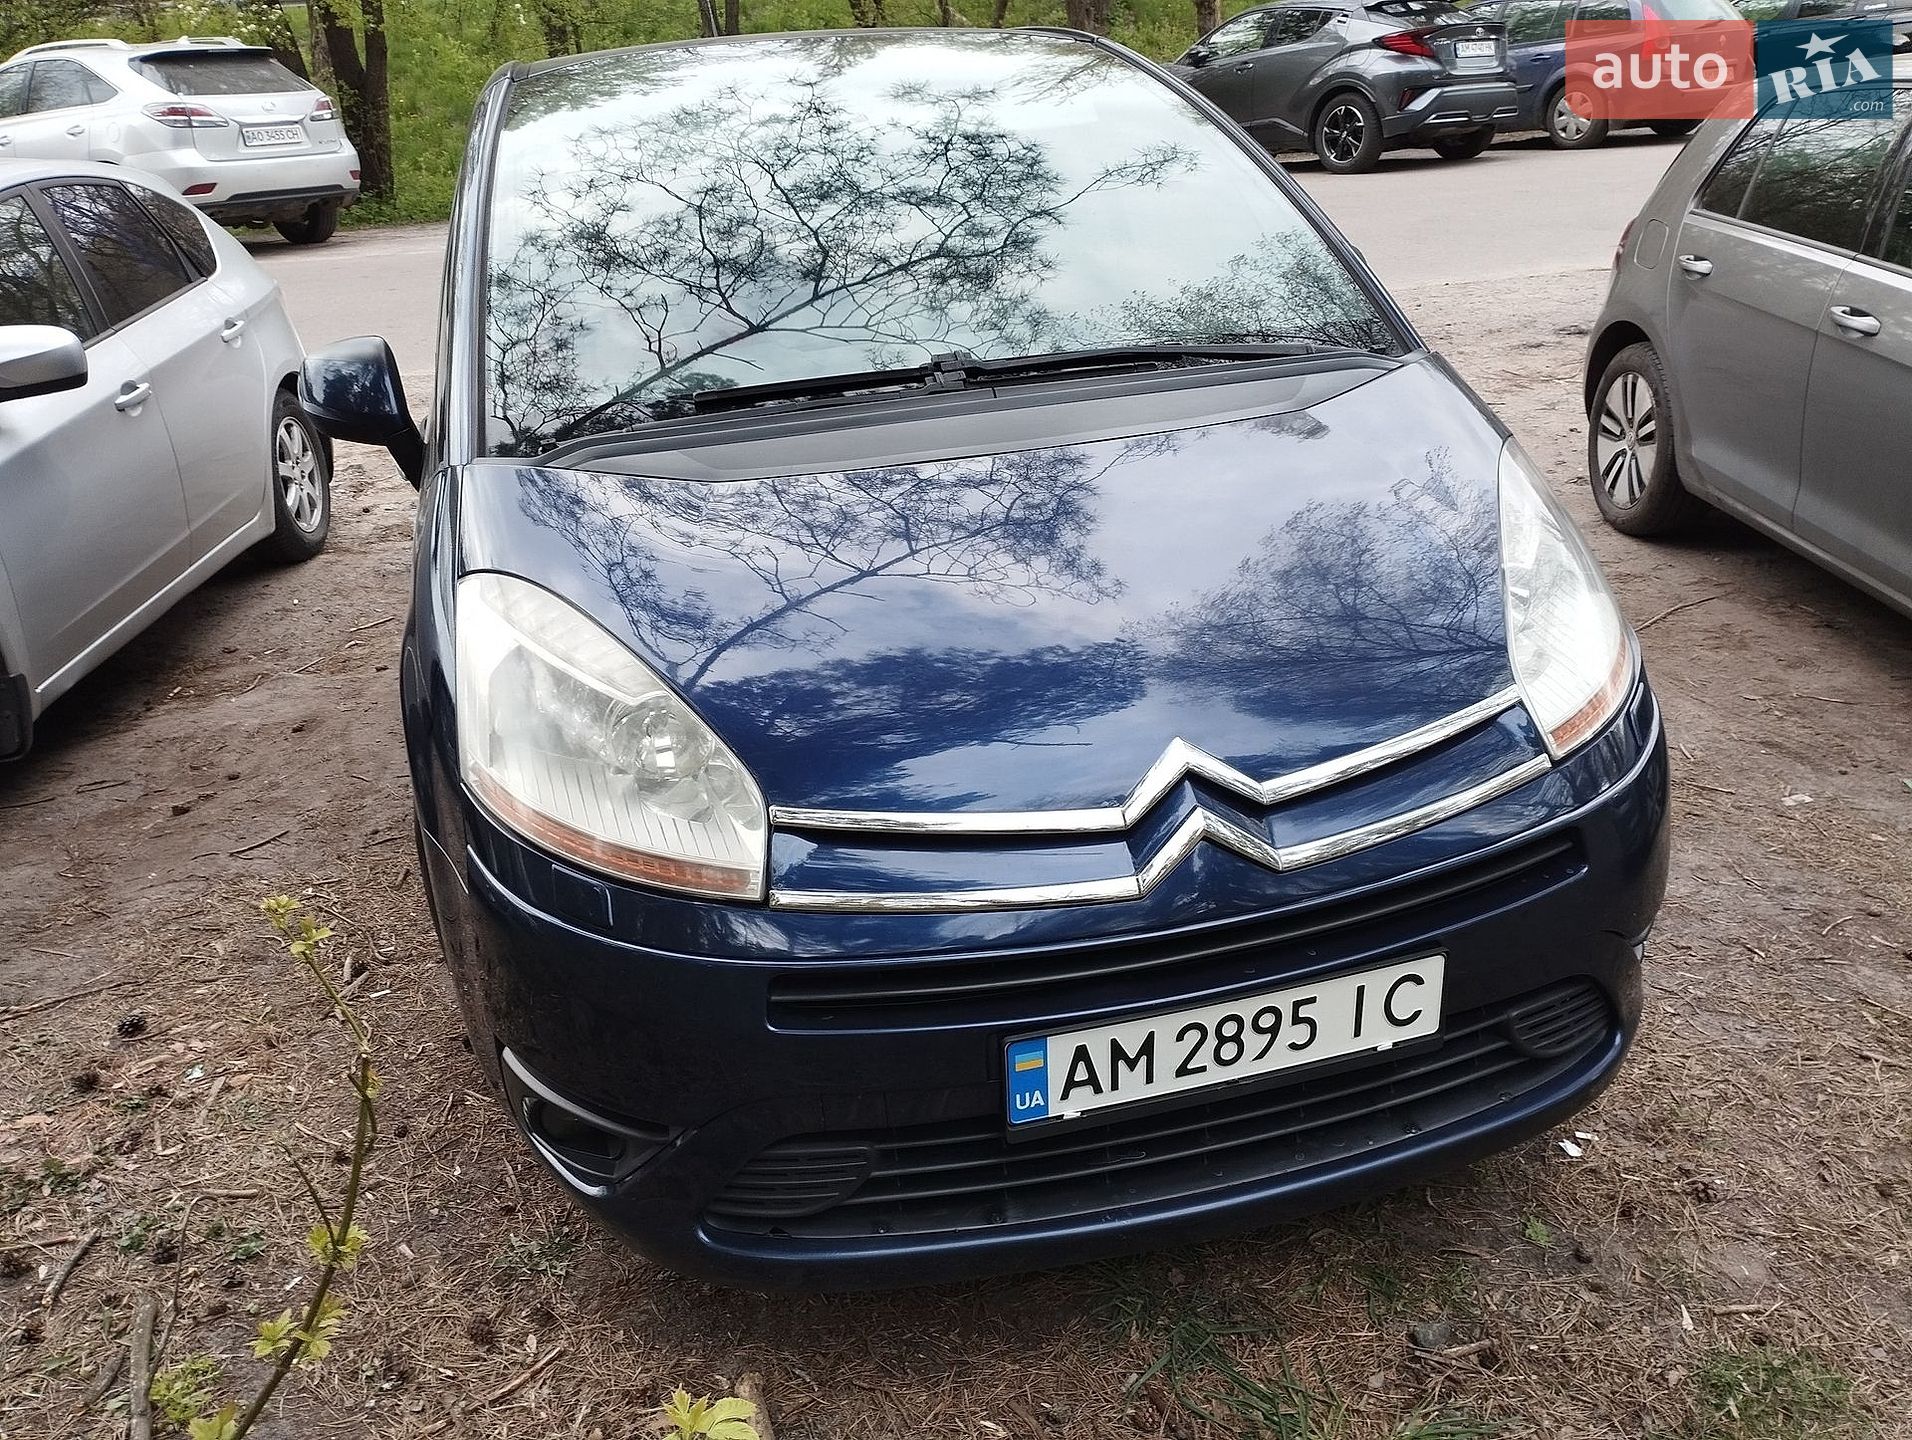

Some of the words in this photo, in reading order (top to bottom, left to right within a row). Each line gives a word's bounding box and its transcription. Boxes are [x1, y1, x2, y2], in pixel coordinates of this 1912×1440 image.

[286, 129, 299, 140] CH
[1059, 1030, 1155, 1102] AM
[1174, 996, 1318, 1079] 2895
[1015, 1089, 1046, 1111] UA
